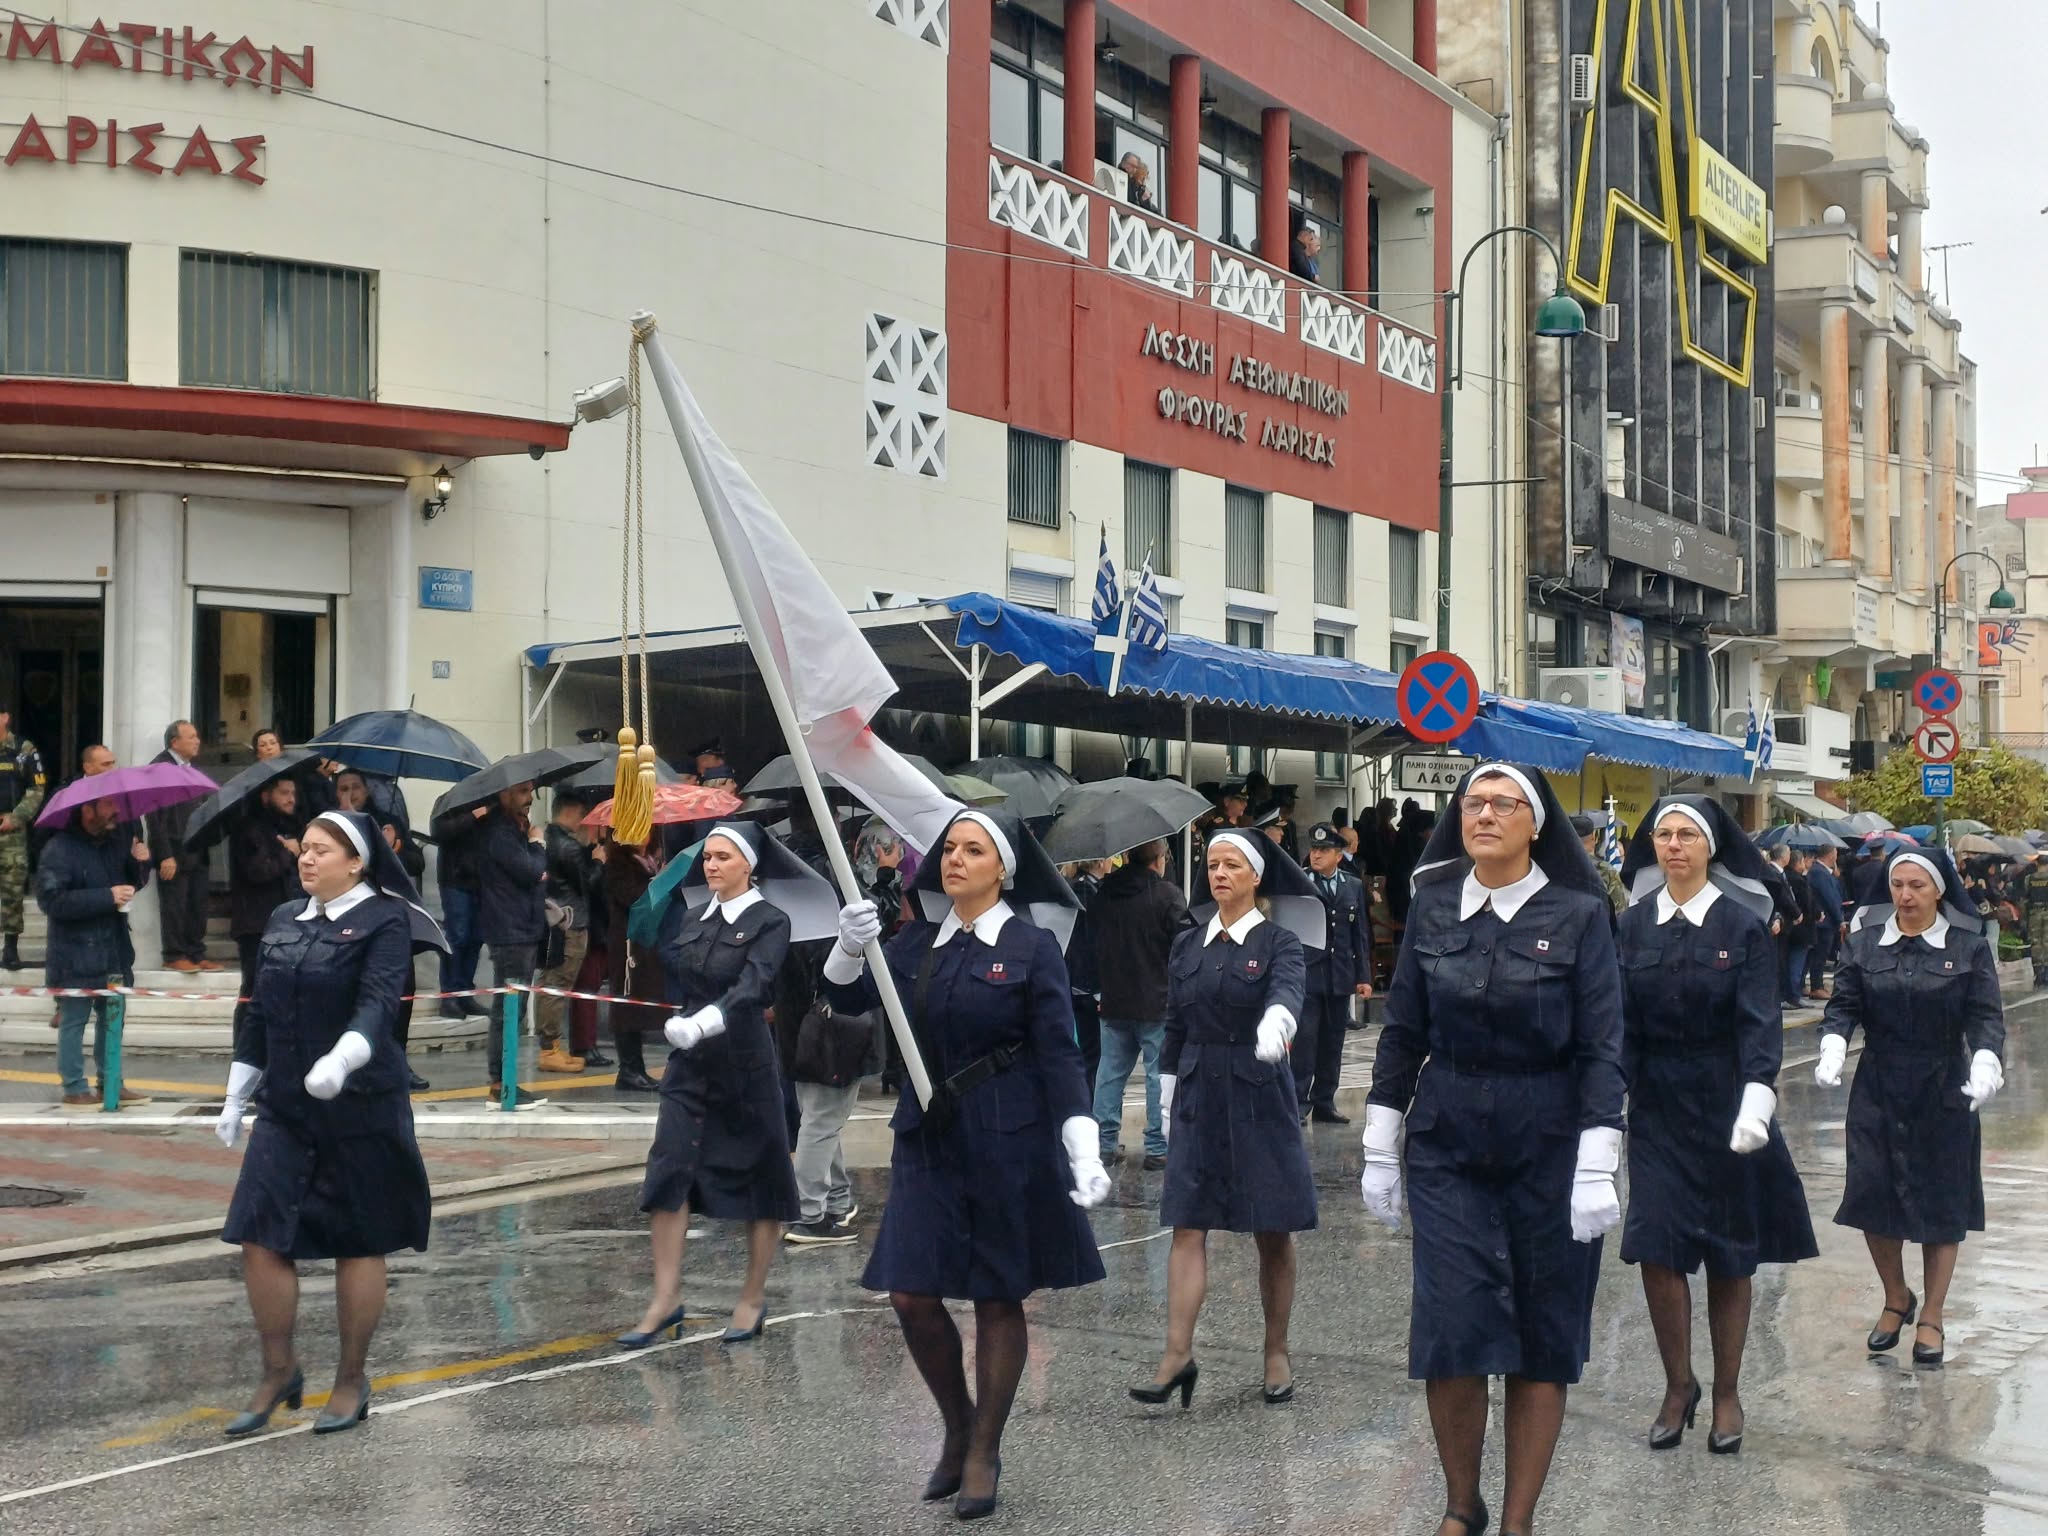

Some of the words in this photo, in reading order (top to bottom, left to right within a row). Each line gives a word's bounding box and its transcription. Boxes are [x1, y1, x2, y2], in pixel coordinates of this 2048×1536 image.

[0, 14, 314, 95] ΜΑΤΙΚΩΝ
[4, 112, 266, 186] ΑΡΙΣΑΣ
[1705, 158, 1761, 229] ALTERLIFE
[1141, 322, 1215, 375] ΛΕΣΧΗ
[1229, 352, 1350, 419] ΑΞΙΩΜΑΤΙΚΩΝ
[1158, 385, 1249, 443] ΦΡΟΥΡΑΣ
[1260, 416, 1336, 468] ΛΑΡΙΣΑΣ
[431, 582, 464, 593] ΚΥΠΡΟΥ
[1406, 761, 1426, 769] ΠΛΗΝ
[1428, 762, 1470, 771] ΟΧΗΜΑΤΩΝ
